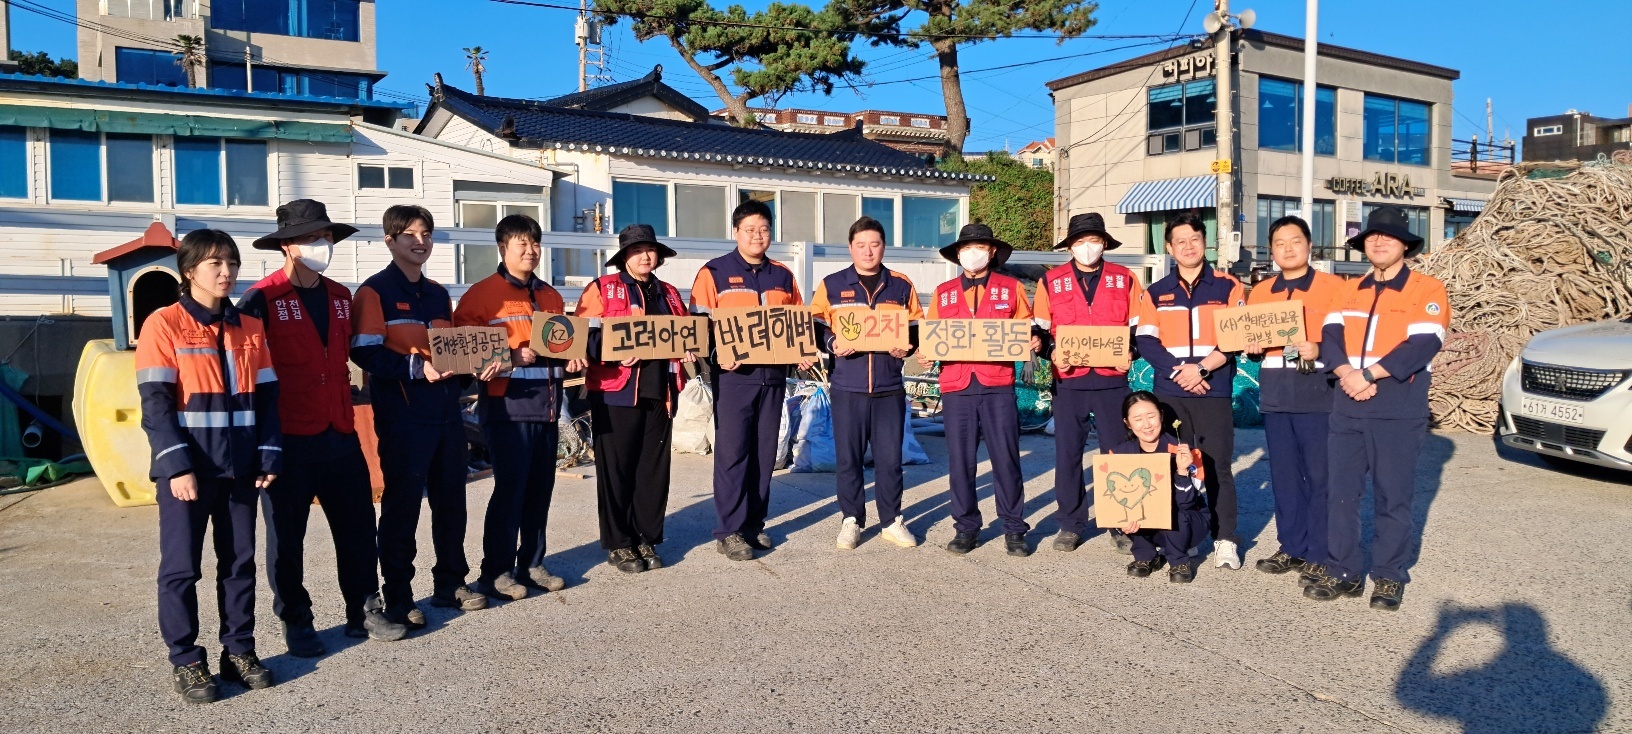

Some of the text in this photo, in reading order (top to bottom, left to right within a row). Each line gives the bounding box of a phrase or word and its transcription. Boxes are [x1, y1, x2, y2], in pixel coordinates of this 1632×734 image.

[1333, 171, 1414, 197] COFFEE ARA
[275, 300, 300, 310] 안전
[551, 328, 566, 341] KZ
[612, 320, 700, 353] 고려아연
[718, 307, 816, 361] 반려해변
[863, 312, 905, 339] 2차
[432, 331, 504, 356] 해양환경공단
[925, 320, 1029, 358] 정화 활동
[1551, 405, 1578, 420] 4552
